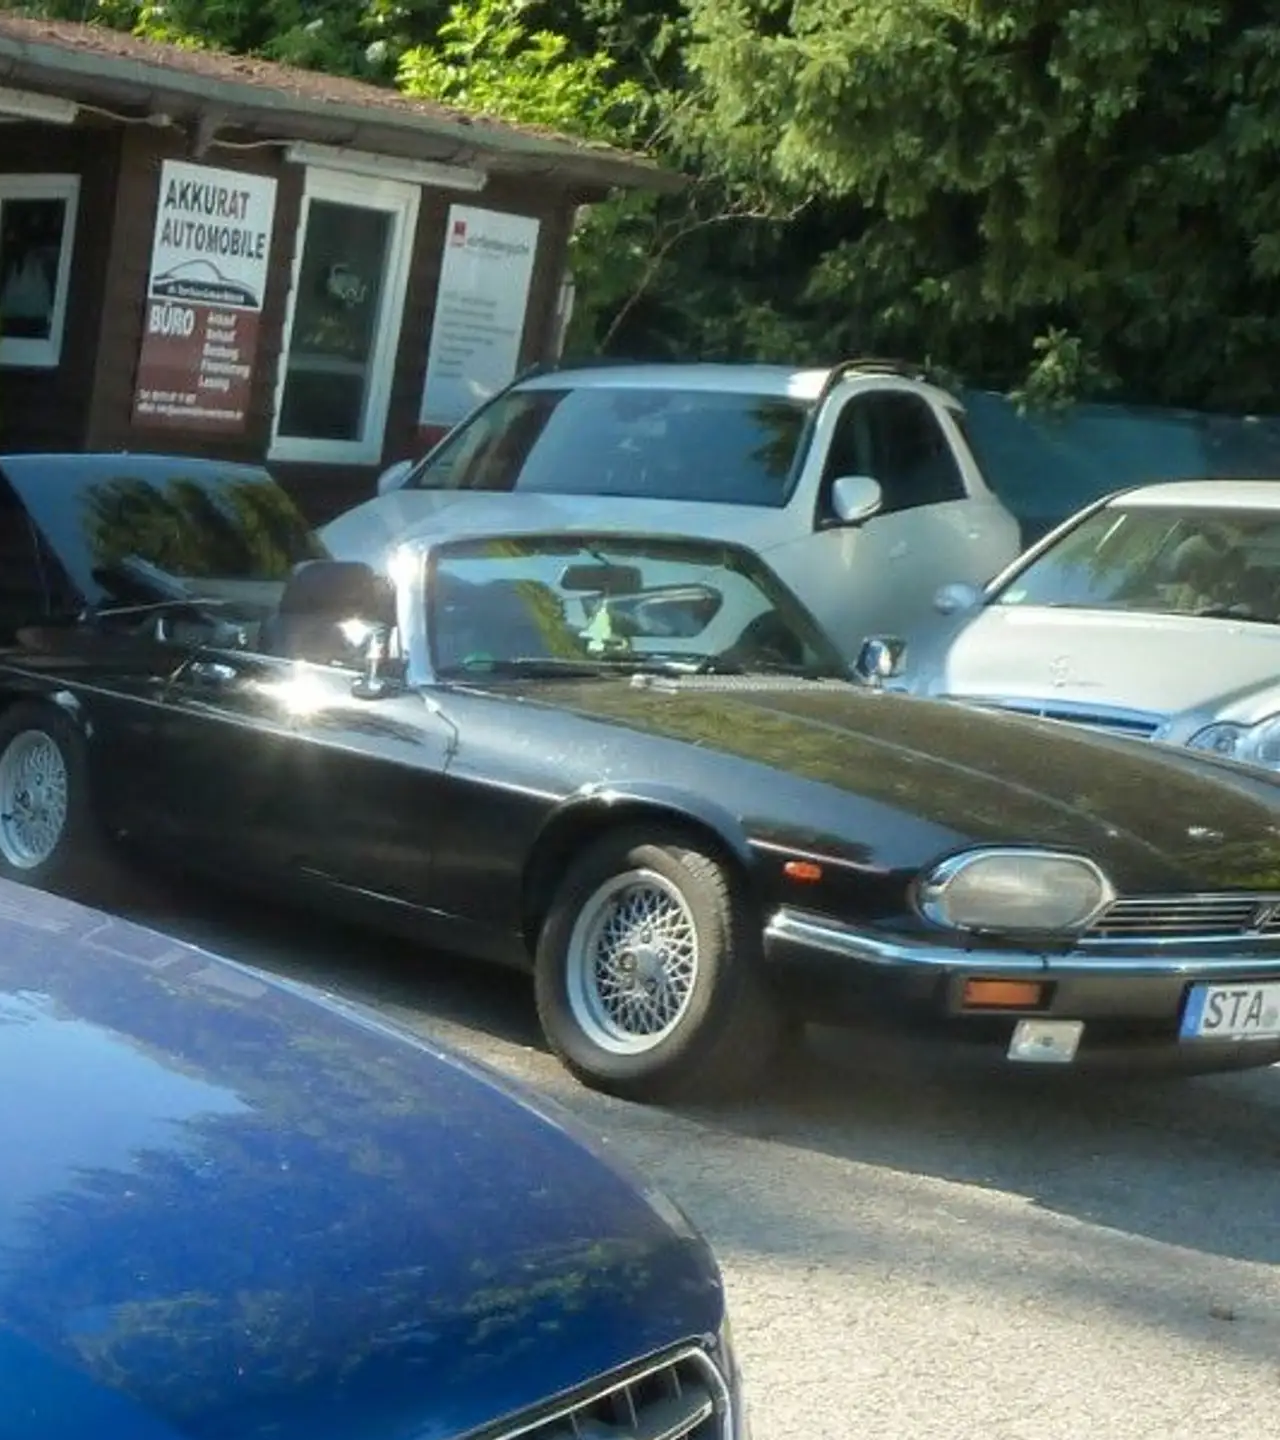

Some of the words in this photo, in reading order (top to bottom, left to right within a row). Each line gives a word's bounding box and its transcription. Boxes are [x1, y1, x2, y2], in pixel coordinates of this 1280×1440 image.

[165, 179, 251, 220] AKKURAT
[160, 218, 267, 259] AUTOMOBILE
[149, 301, 195, 336] BÜRO
[1203, 988, 1263, 1029] STA
